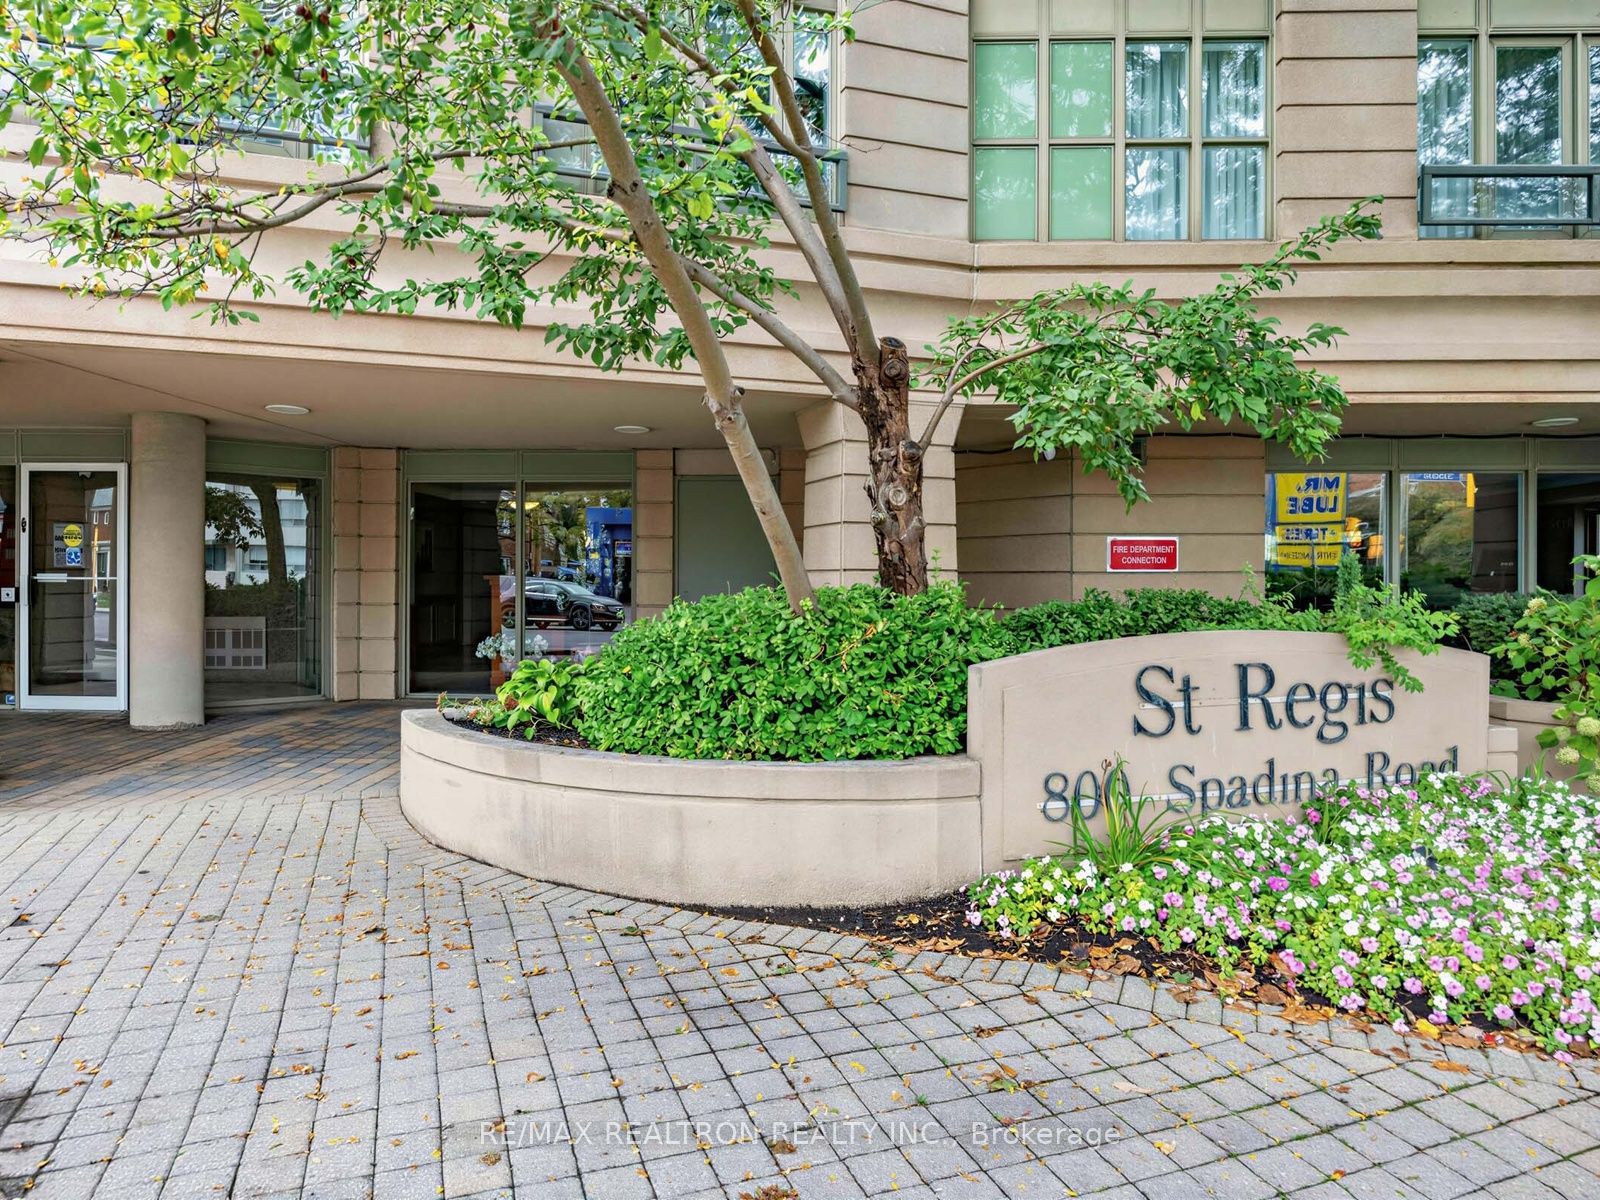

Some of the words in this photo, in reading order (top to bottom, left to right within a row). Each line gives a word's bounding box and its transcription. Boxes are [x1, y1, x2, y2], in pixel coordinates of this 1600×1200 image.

[1112, 545, 1128, 554] FIRE
[1129, 545, 1175, 554] DEPARTMENT
[1121, 556, 1167, 564] CONNECTION
[1133, 664, 1202, 738] St
[1234, 662, 1396, 744] Regis
